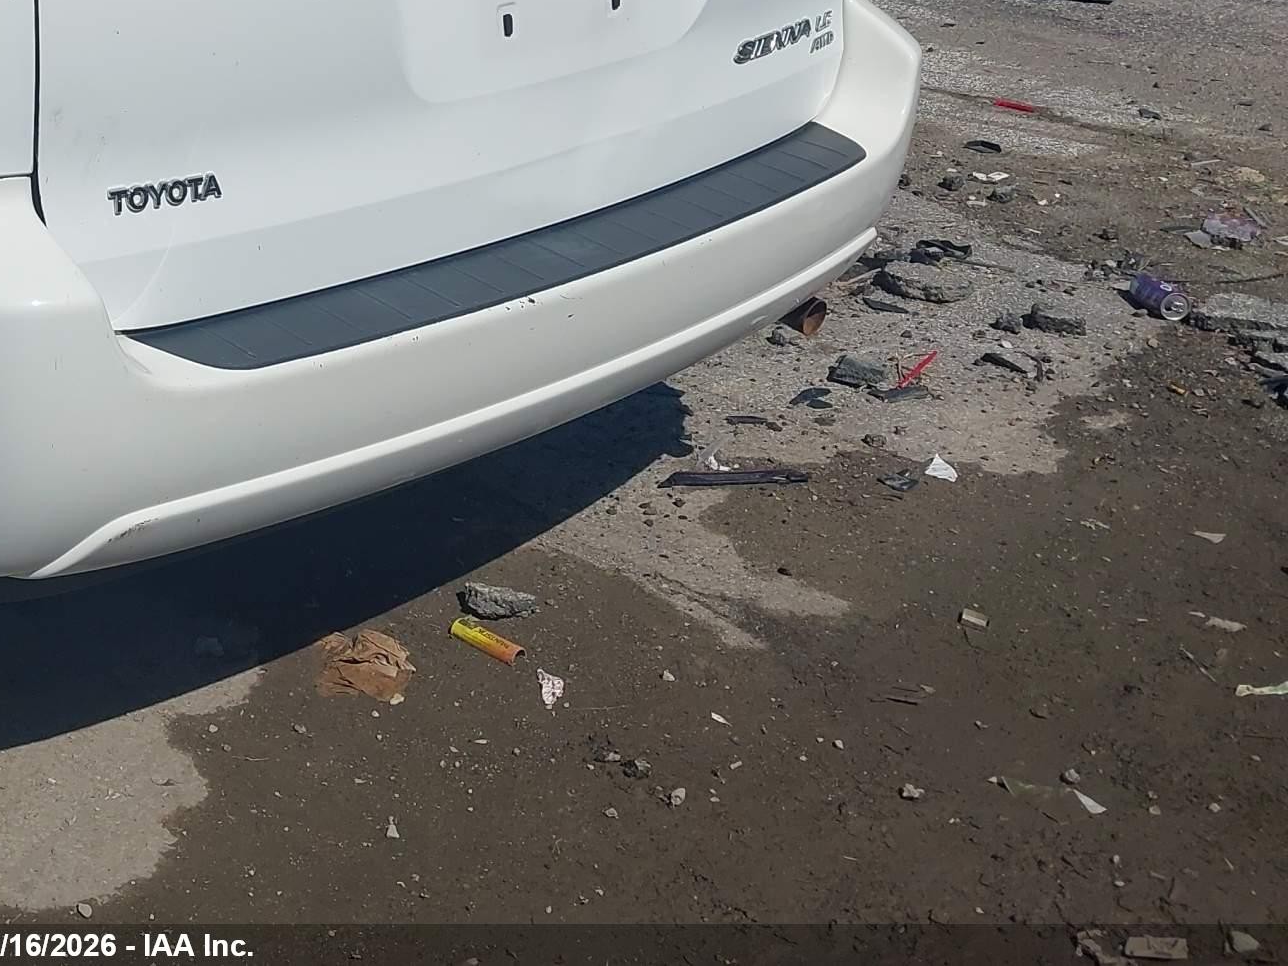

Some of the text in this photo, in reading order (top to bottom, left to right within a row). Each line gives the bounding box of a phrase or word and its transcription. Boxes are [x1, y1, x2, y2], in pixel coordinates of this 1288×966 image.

[733, 10, 833, 64] SIENNA LE
[107, 172, 222, 216] TOYOTA
